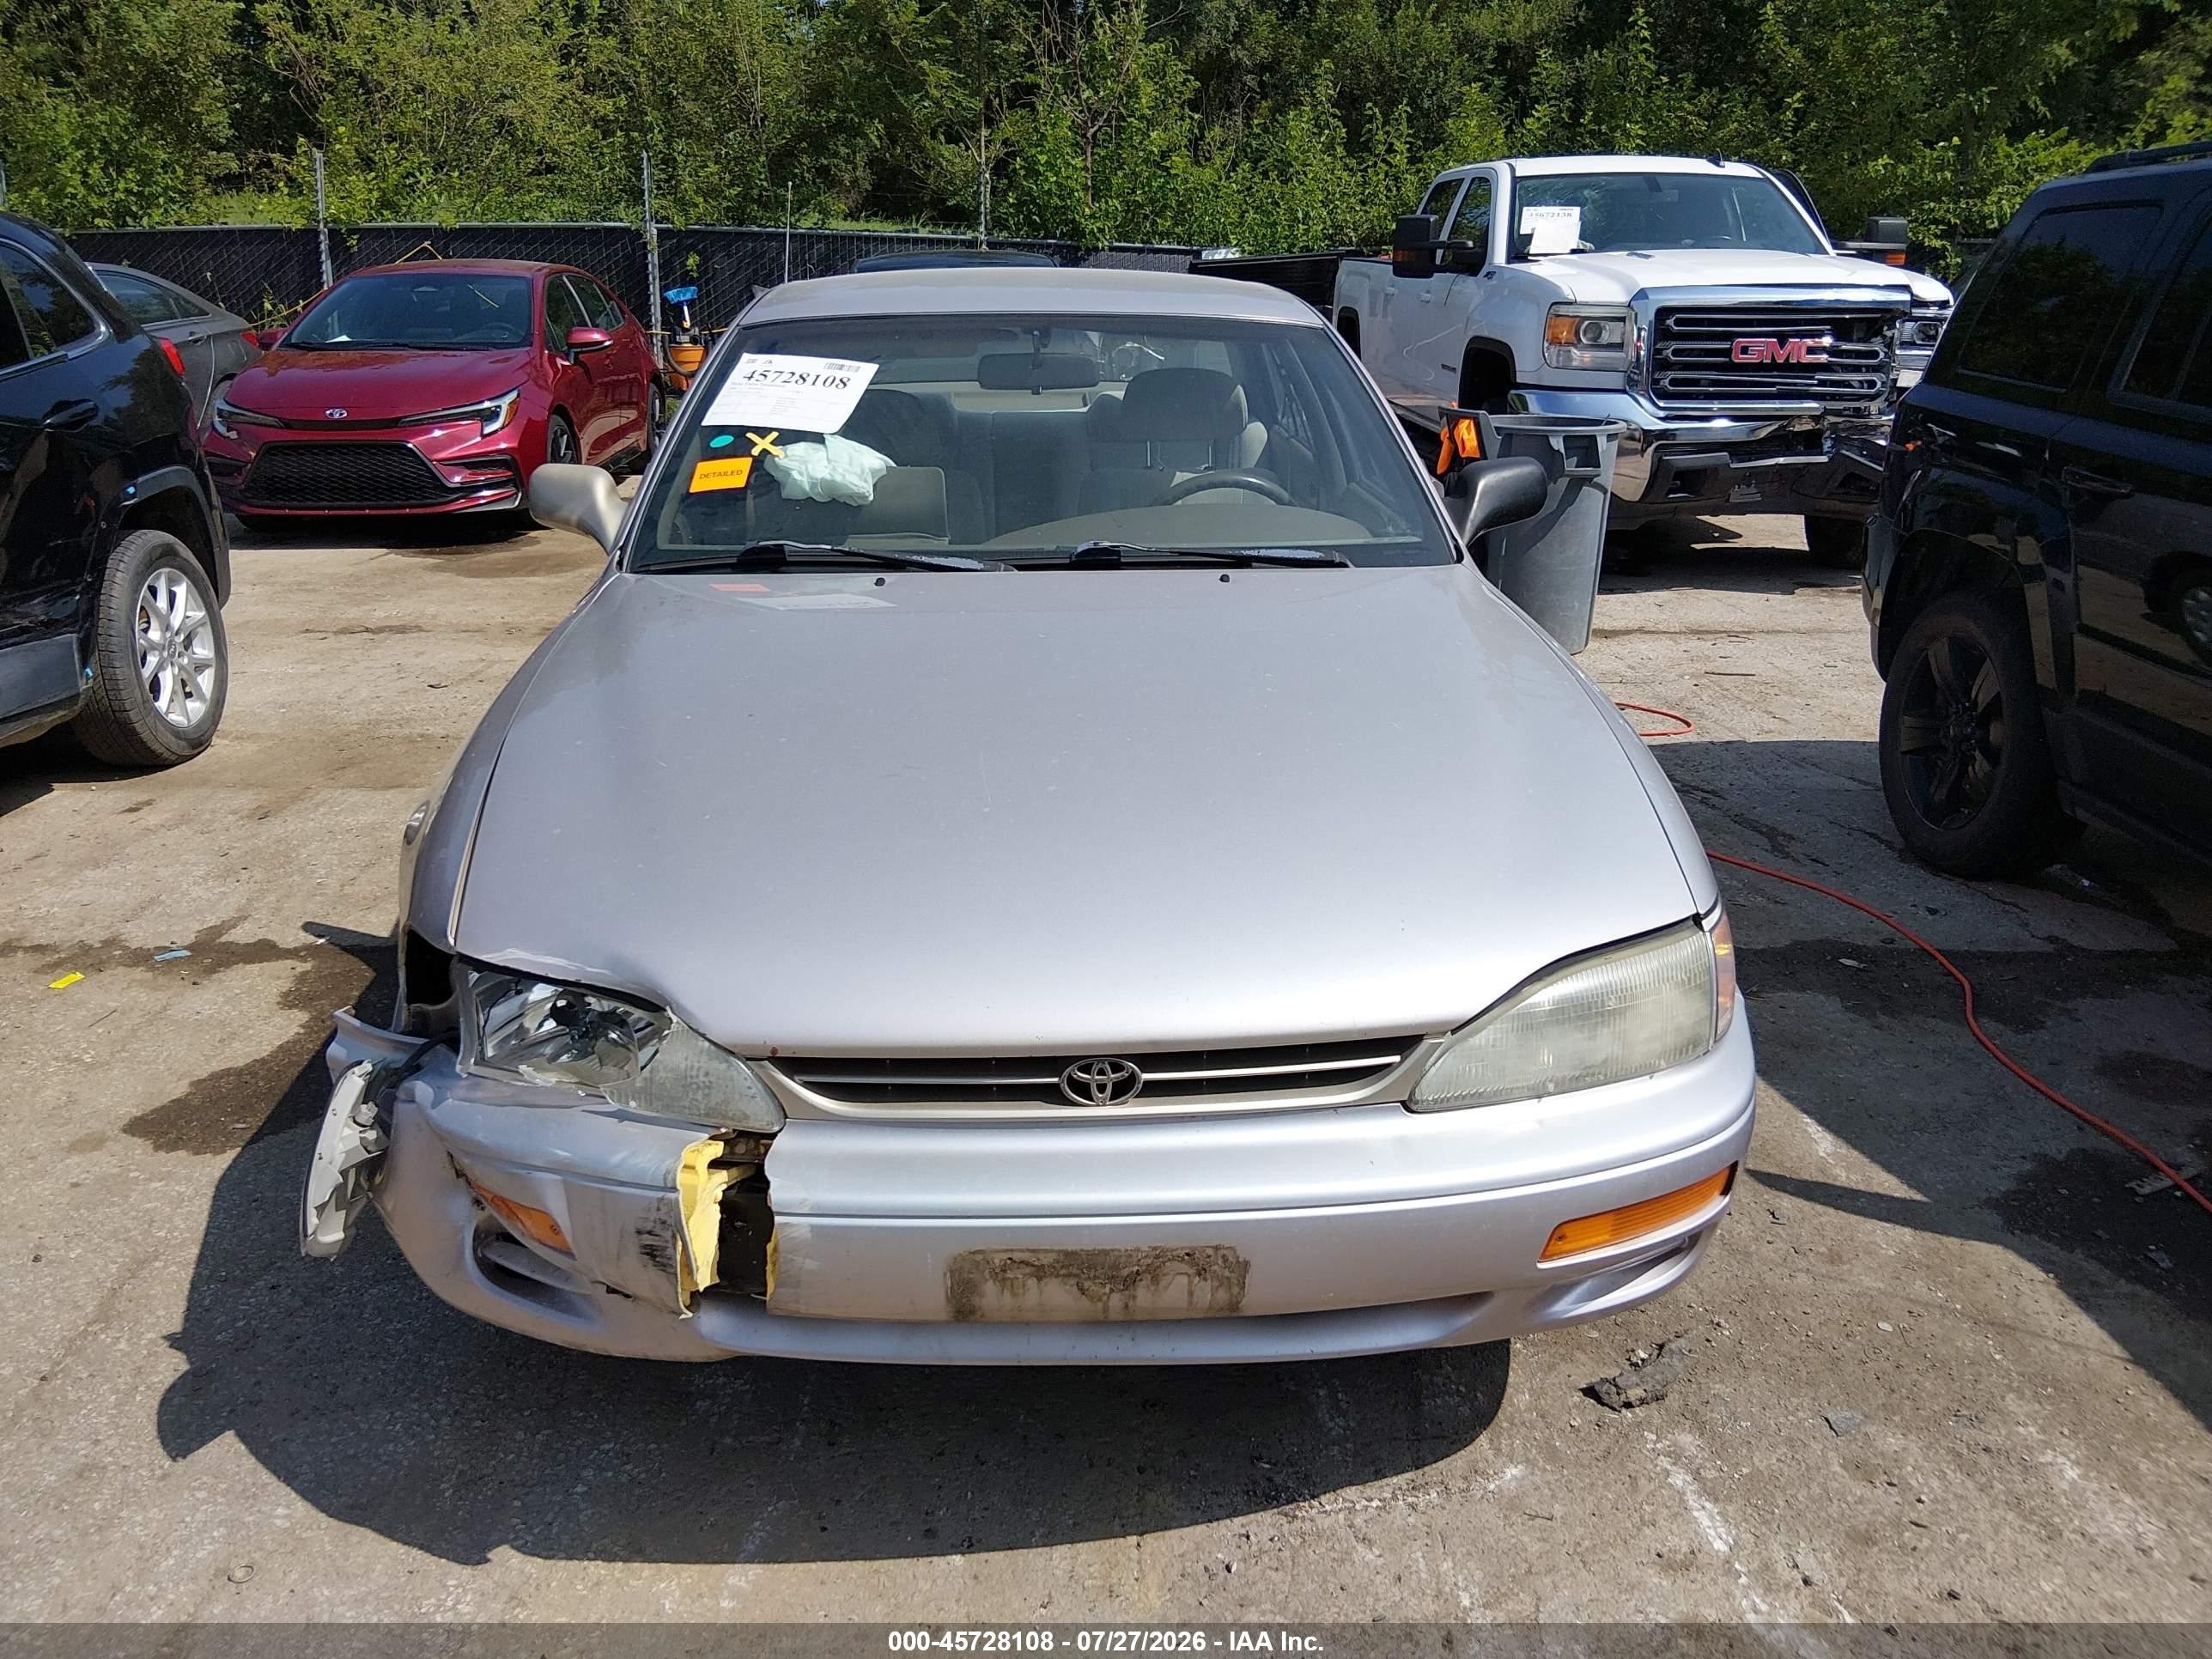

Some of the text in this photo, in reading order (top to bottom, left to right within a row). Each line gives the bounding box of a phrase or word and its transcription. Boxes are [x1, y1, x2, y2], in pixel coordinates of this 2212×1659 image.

[1731, 338, 1830, 363] GMC
[743, 369, 852, 390] 45728108
[698, 469, 744, 481] DETAILED
